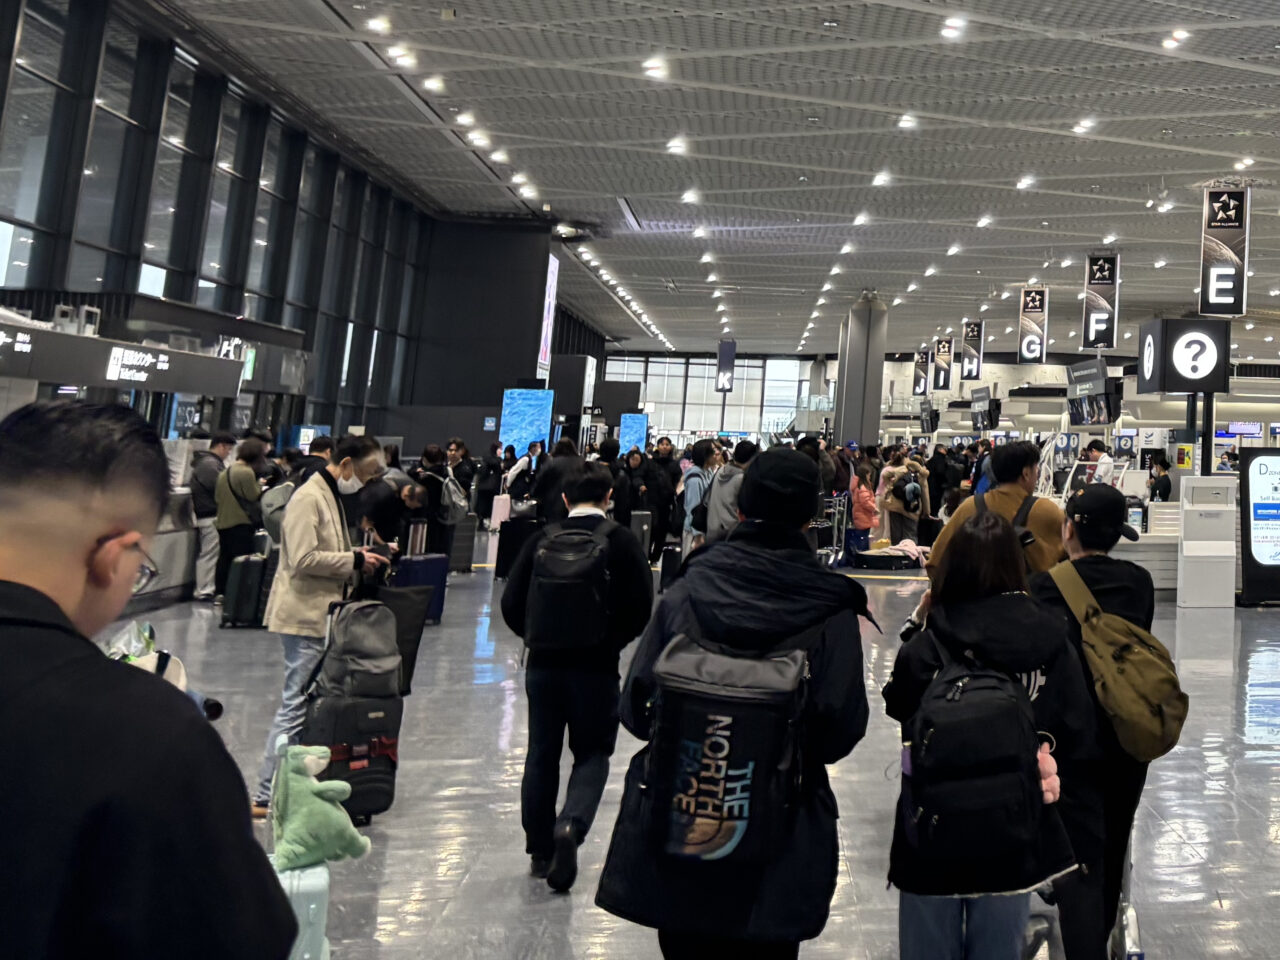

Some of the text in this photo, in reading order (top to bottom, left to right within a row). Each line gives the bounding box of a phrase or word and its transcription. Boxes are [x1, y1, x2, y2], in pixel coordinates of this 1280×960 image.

[1209, 267, 1236, 304] E
[1089, 312, 1110, 341] F
[1021, 334, 1041, 359] G
[963, 357, 978, 377] H
[717, 372, 732, 390] K
[915, 378, 925, 394] J
[1259, 463, 1269, 475] D
[696, 714, 733, 818] NORTH
[723, 761, 755, 818] THE
